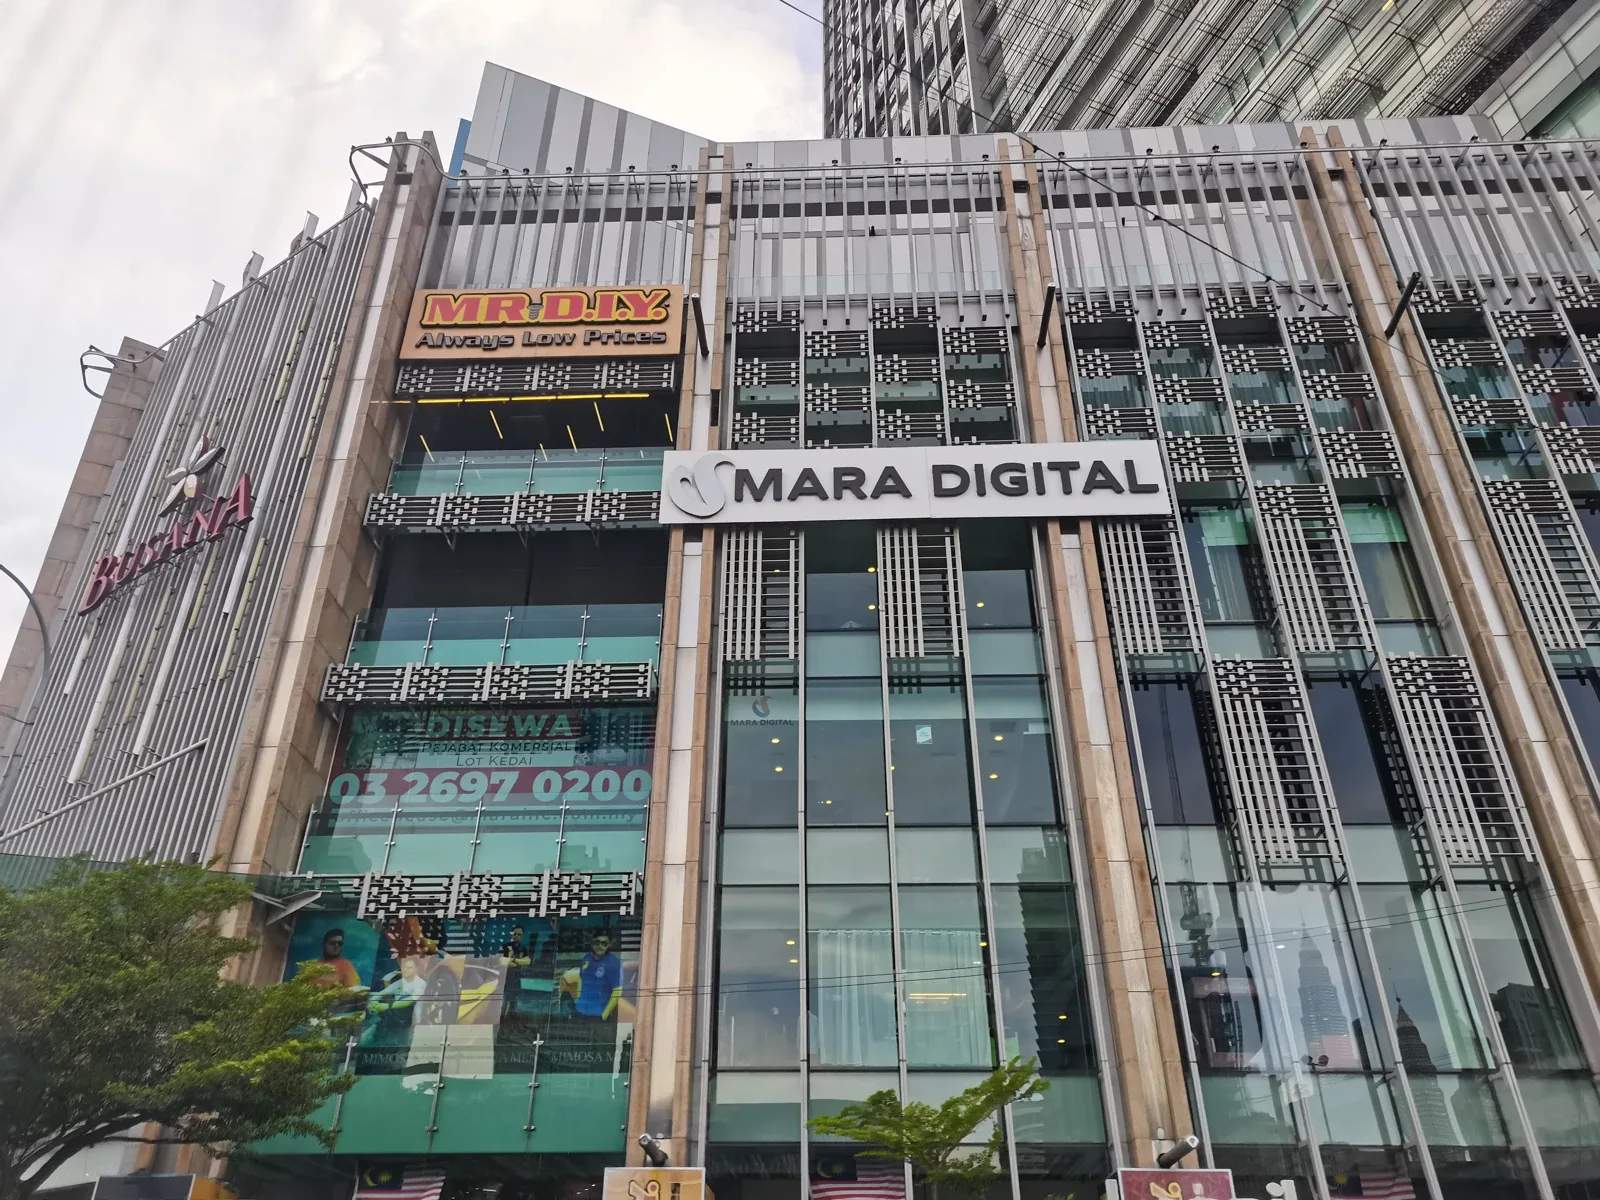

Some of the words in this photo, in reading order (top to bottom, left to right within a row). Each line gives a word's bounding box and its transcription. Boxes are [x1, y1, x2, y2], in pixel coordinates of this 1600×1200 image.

[415, 332, 514, 350] Always
[522, 331, 576, 346] Low
[584, 329, 667, 345] Prices
[734, 466, 912, 502] MARA
[932, 459, 1160, 497] DIGITAL
[78, 473, 254, 617] BUSANA
[427, 714, 573, 738] DISEWA
[421, 742, 485, 753] PEJABAT
[489, 741, 573, 752] KOMERSIAL
[329, 772, 388, 805] 03
[400, 770, 520, 804] 2697
[532, 769, 653, 801] 0200
